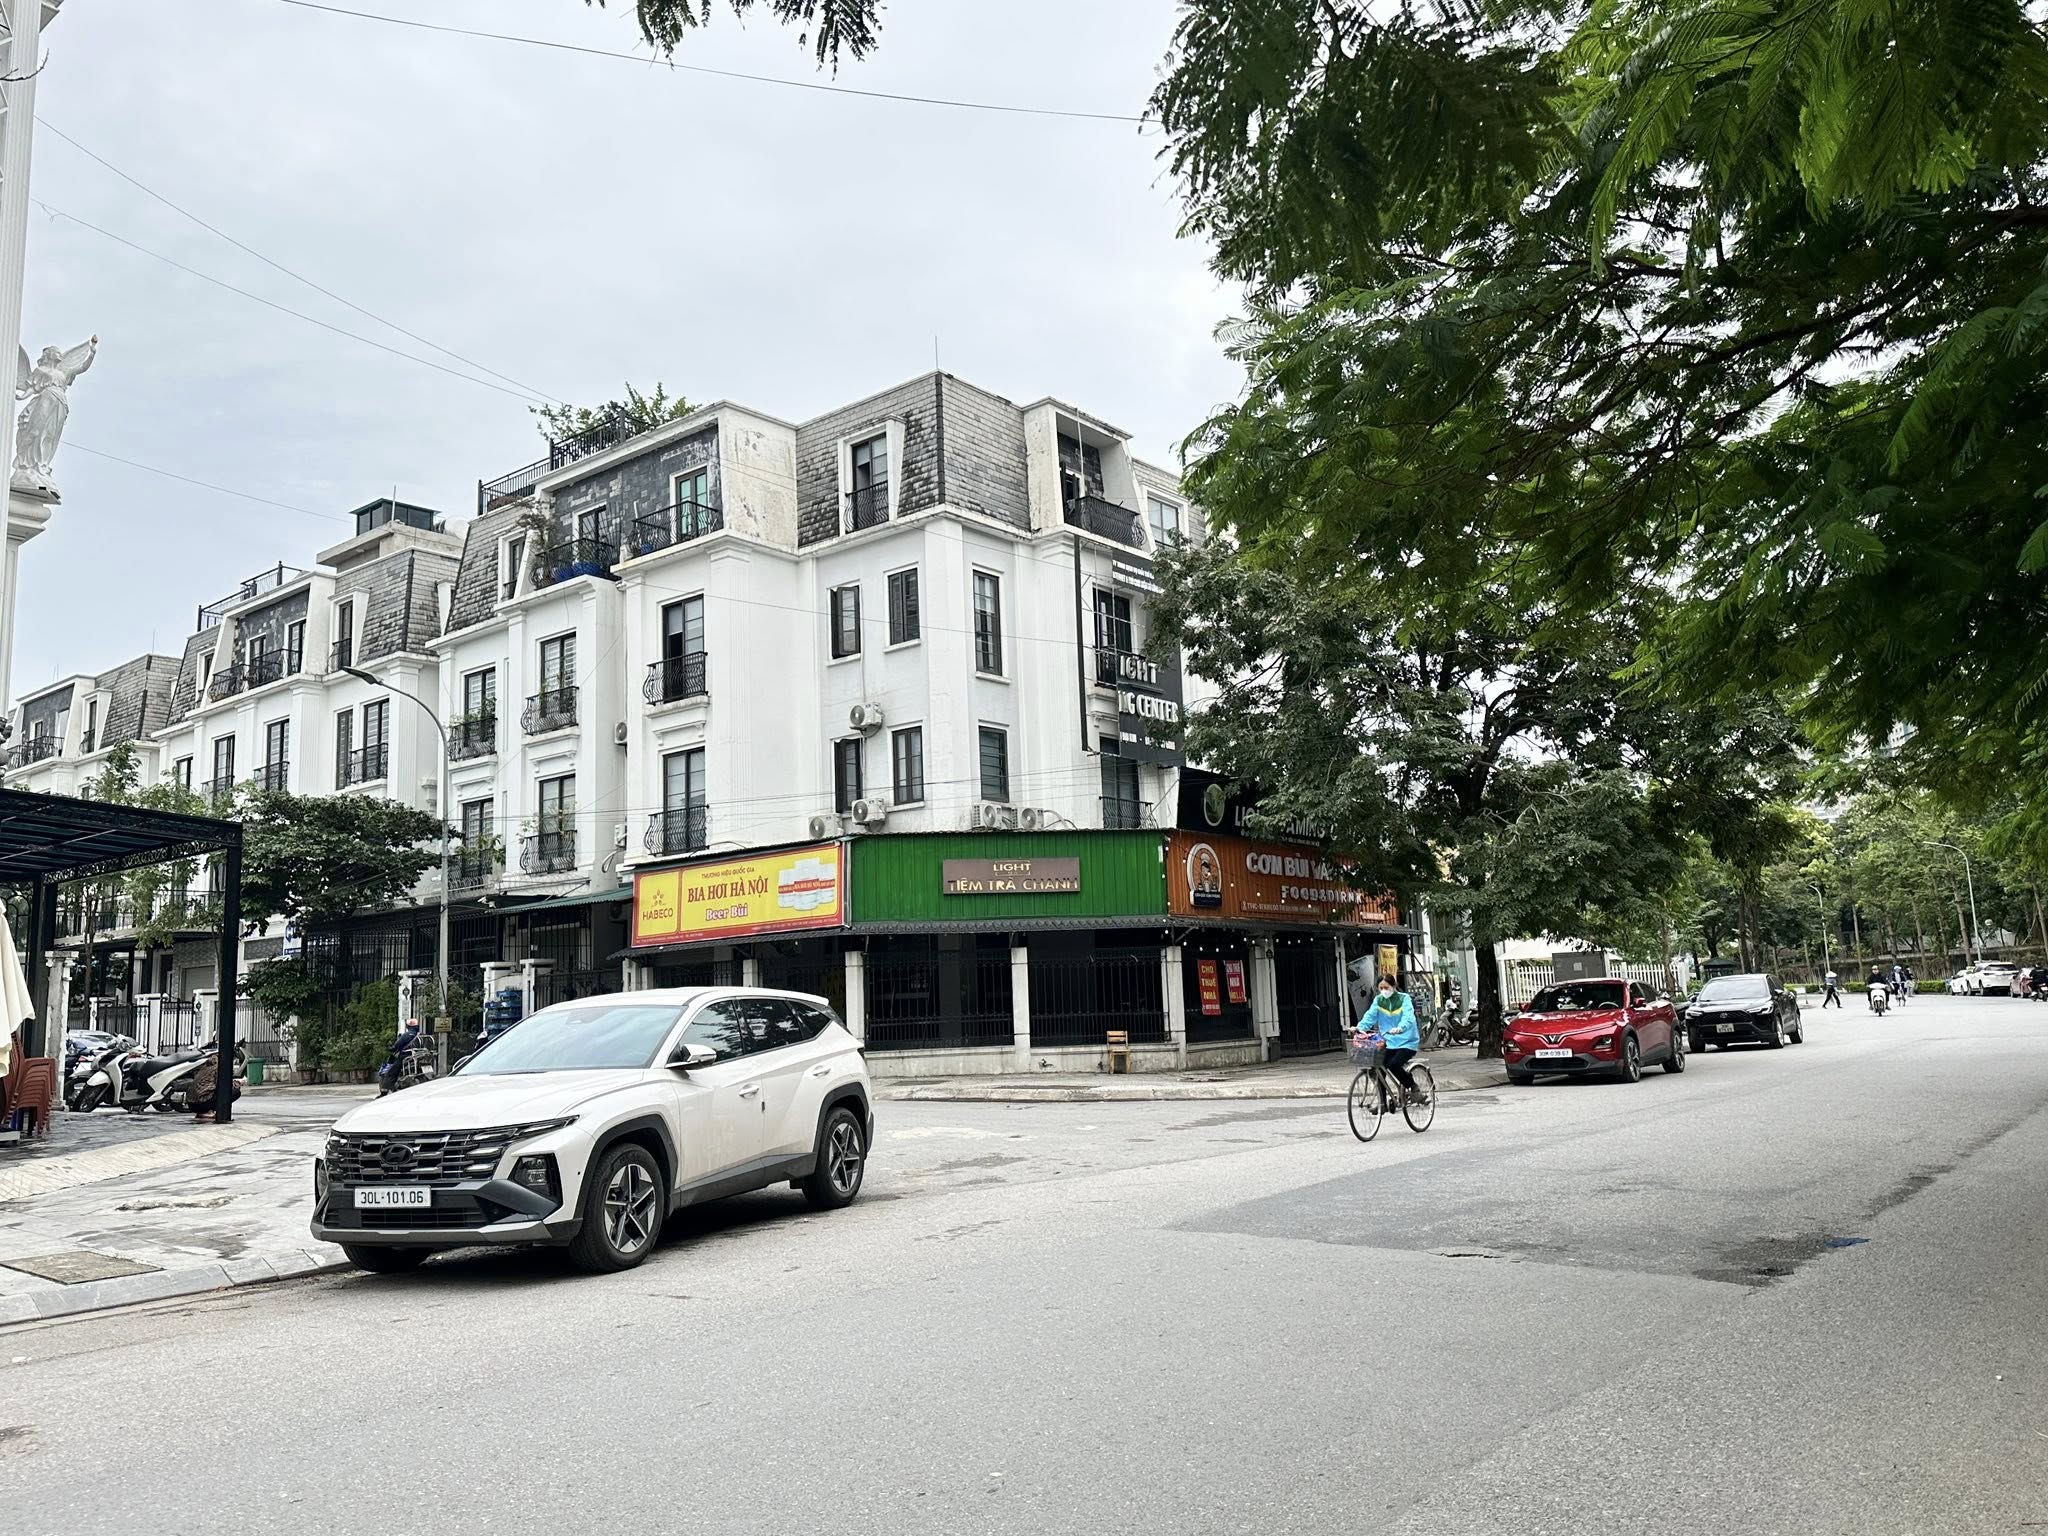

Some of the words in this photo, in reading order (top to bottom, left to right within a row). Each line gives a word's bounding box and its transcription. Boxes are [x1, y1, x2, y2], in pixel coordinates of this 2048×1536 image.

[1136, 694, 1179, 723] CENTER
[993, 863, 1031, 872] LIGHT
[687, 886, 706, 903] BIA
[707, 883, 727, 901] HƠI
[730, 877, 746, 897] HÀ
[747, 875, 769, 898] NỘI
[947, 878, 983, 893] TIỆM
[1022, 878, 1078, 890] CHANH
[642, 907, 674, 921] HABECO
[705, 908, 729, 921] Beer
[360, 1191, 424, 1204] 30L-101.06
